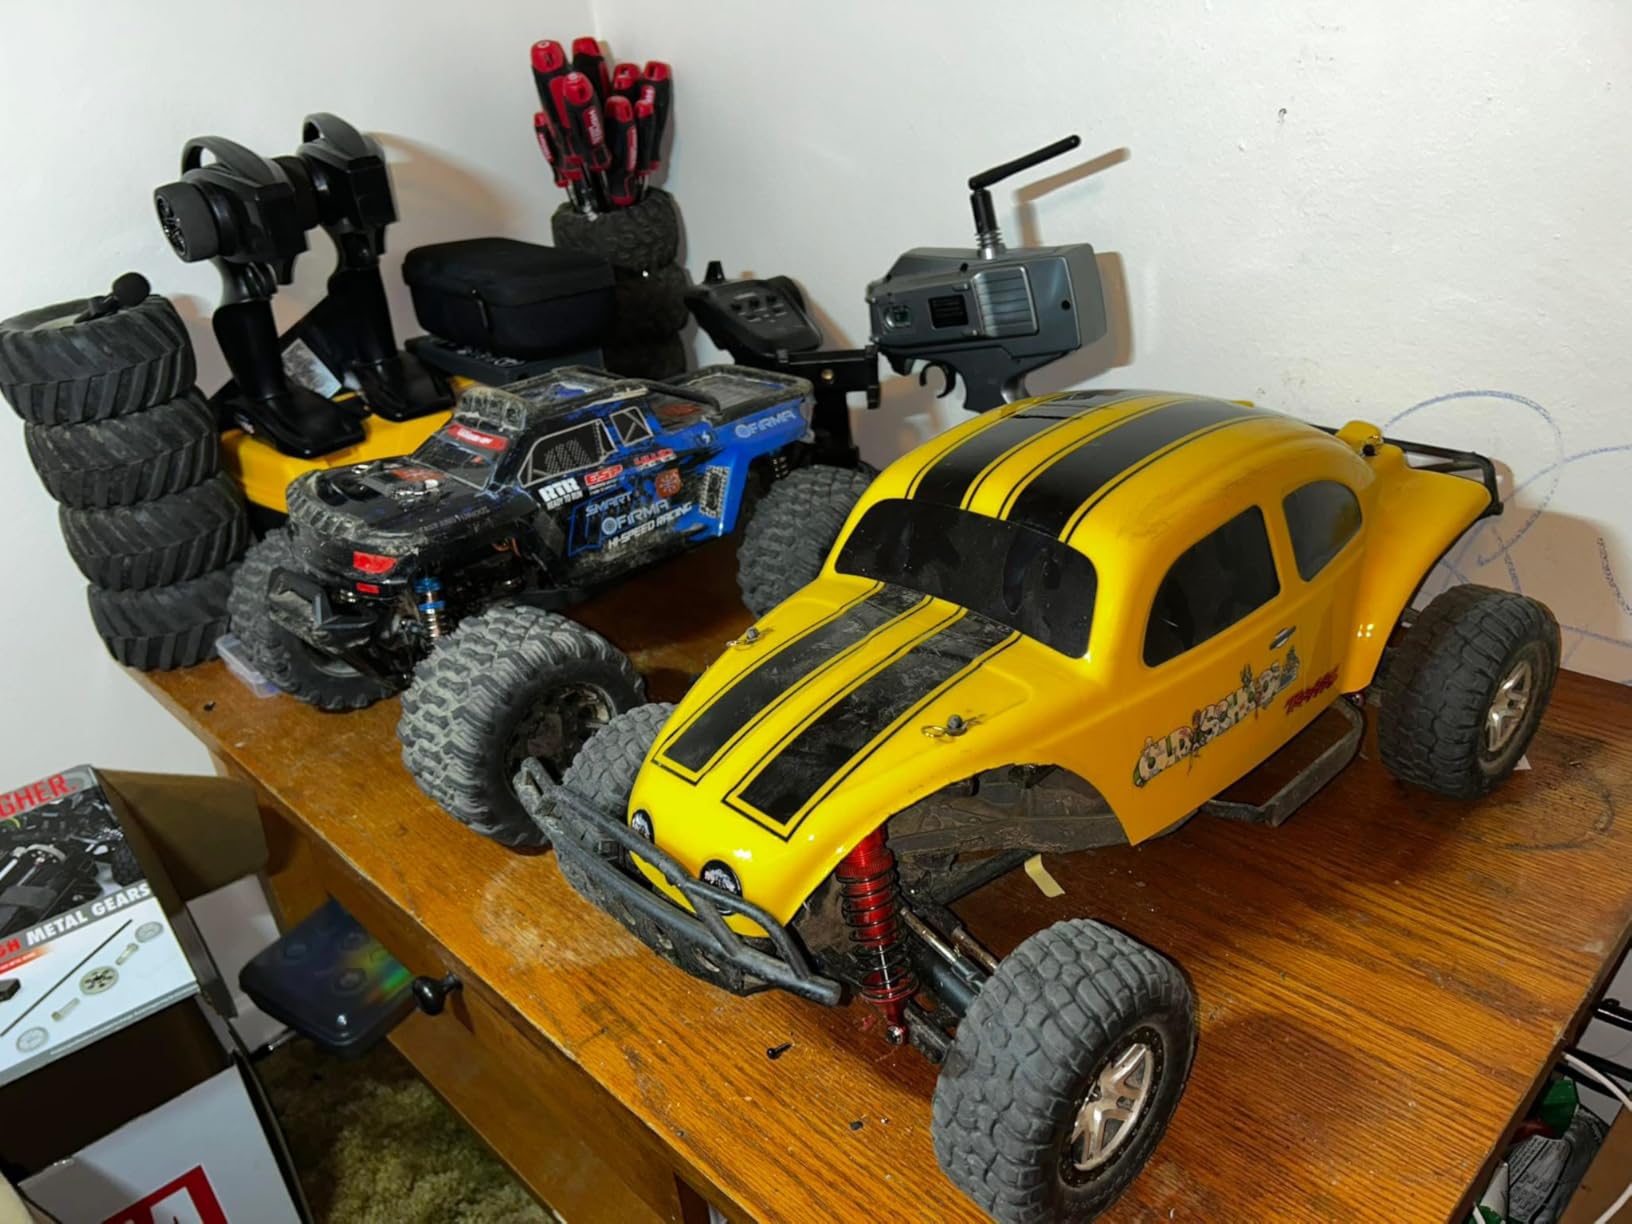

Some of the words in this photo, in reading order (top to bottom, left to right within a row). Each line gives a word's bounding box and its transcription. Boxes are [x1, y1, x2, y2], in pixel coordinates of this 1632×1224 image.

[538, 477, 580, 502] RTR
[585, 491, 633, 517] SMART
[607, 519, 656, 551] HI-SPEED
[656, 501, 693, 527] RACING
[616, 499, 670, 529] FIRMA
[26, 910, 88, 947] METAL
[91, 882, 150, 917] GEARS
